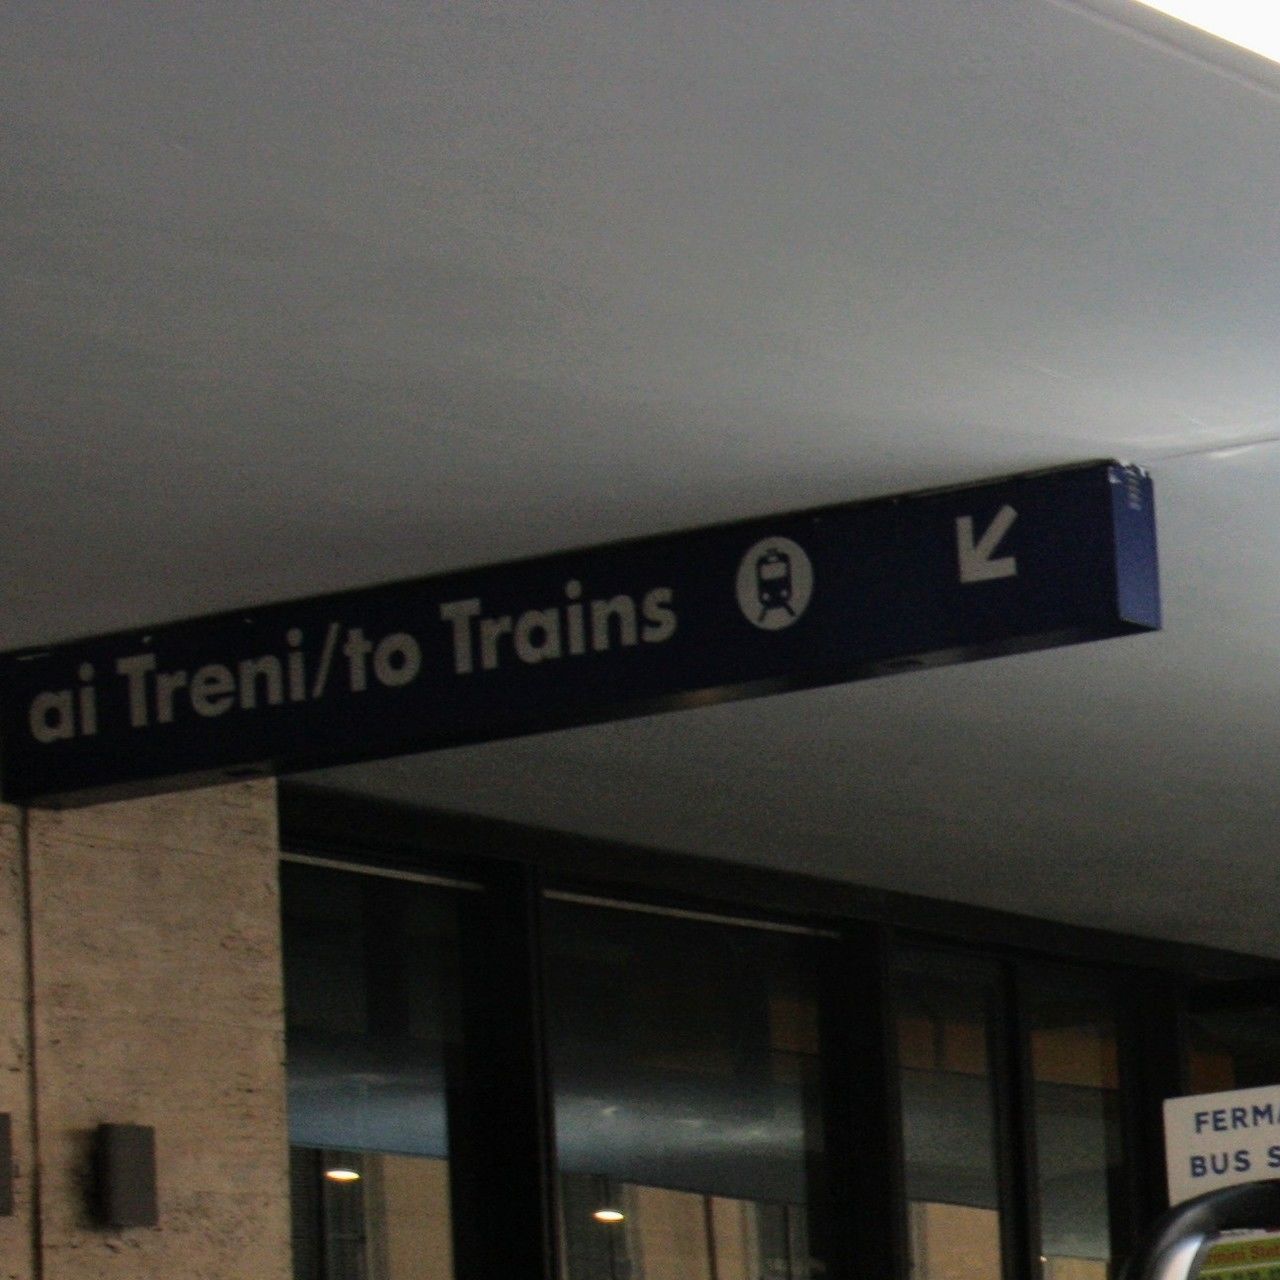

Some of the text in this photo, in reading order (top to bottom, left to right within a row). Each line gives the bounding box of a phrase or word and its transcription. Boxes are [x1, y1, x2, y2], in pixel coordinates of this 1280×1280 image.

[30, 578, 678, 744] ai Treni/to Trains
[1190, 1146, 1251, 1178] BUS
